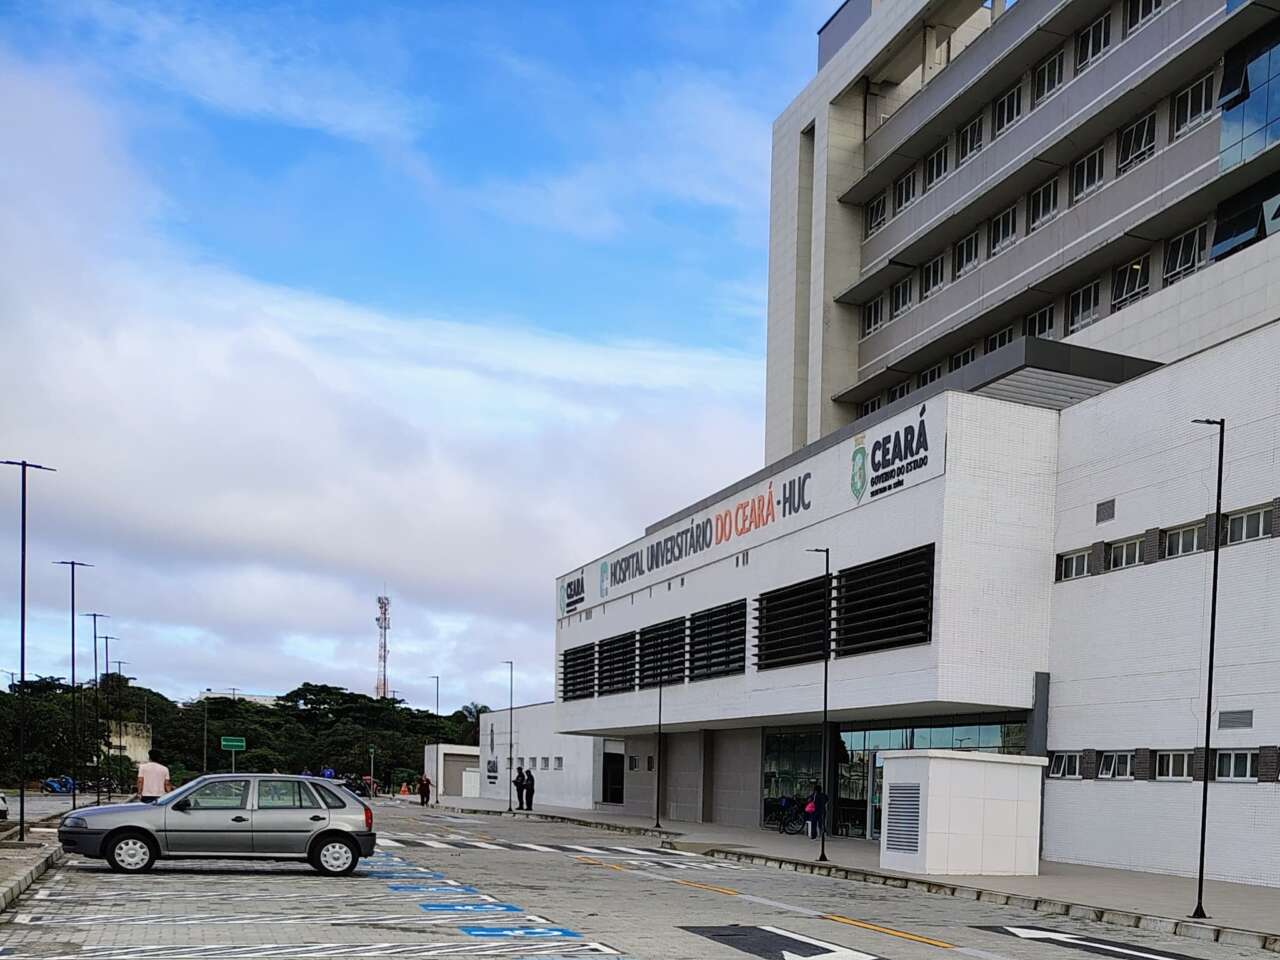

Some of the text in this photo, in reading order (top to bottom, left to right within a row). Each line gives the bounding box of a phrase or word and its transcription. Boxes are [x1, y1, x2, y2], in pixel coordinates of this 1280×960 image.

[870, 403, 929, 473] CEARÁ
[897, 464, 905, 478] DO
[905, 455, 929, 474] ESTADO
[609, 549, 646, 588] HOSPITAL
[646, 517, 713, 573] UNIVERSITÁRIO
[714, 509, 732, 546] DO
[735, 480, 776, 537] CEARÁ
[782, 472, 812, 518] HUC
